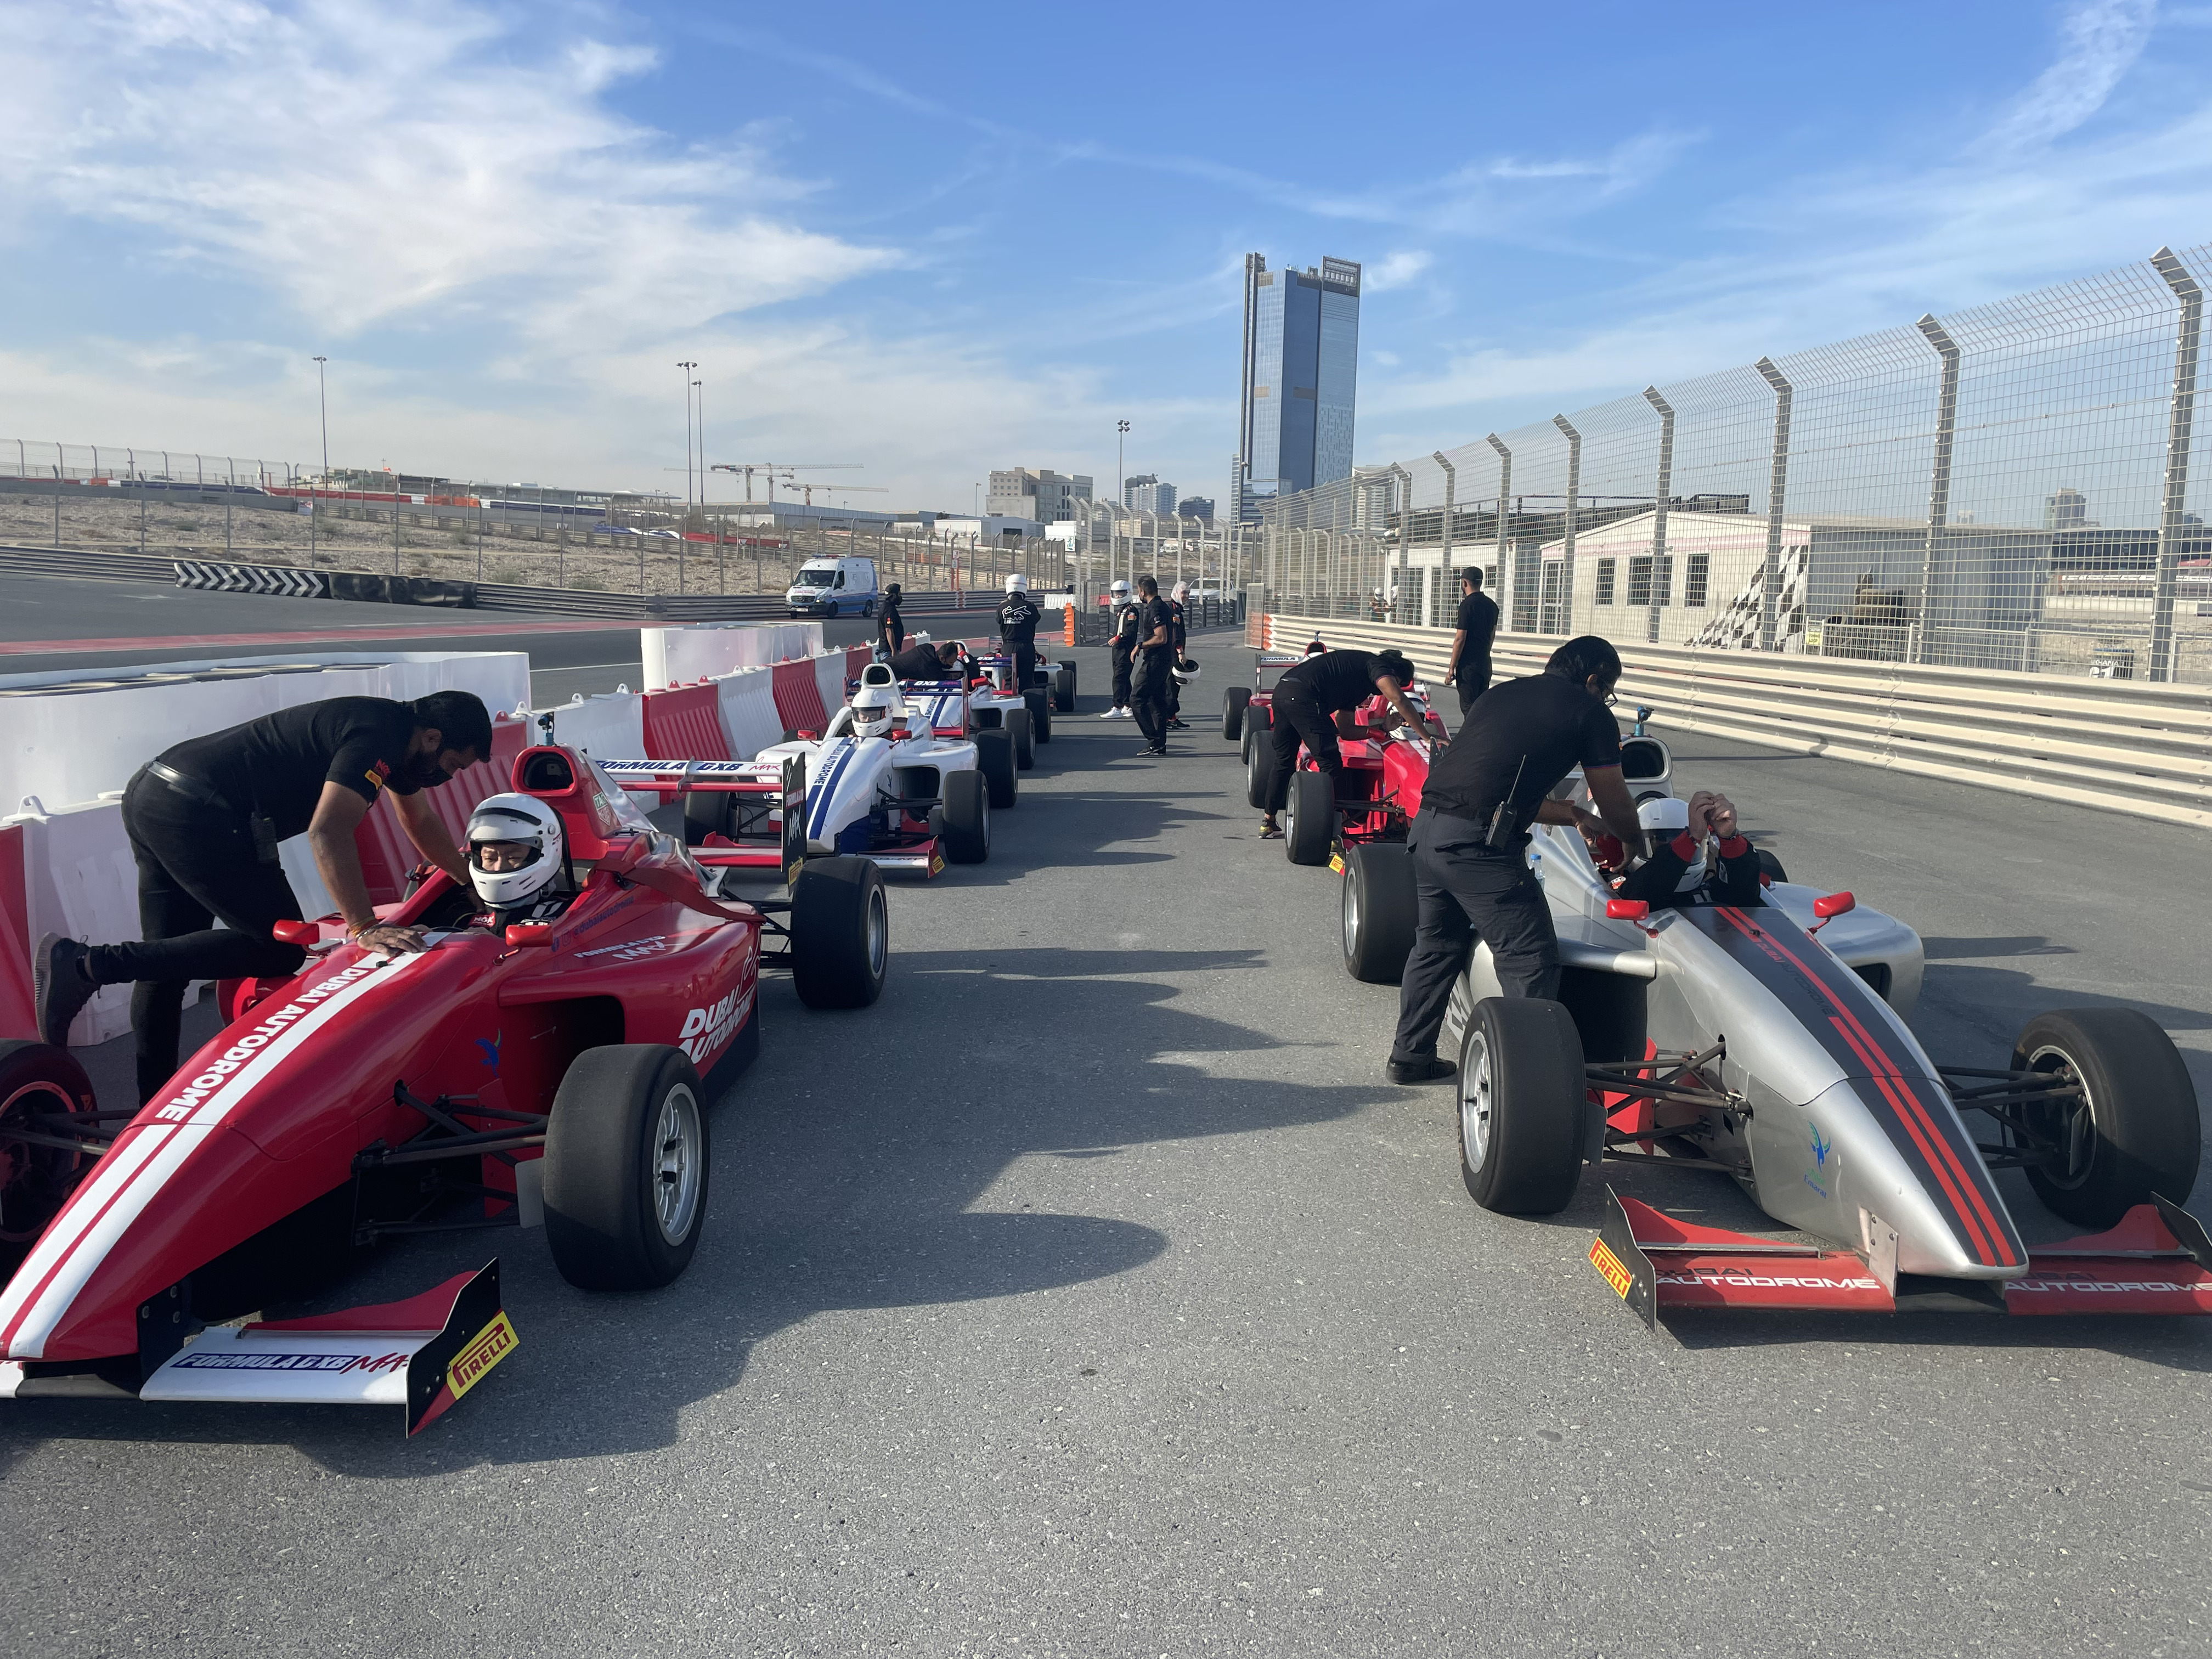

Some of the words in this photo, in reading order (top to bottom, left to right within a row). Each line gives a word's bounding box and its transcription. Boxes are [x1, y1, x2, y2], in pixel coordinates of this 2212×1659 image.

[295, 968, 369, 1003] DUBAI
[679, 984, 740, 1039] DUBAI
[155, 1004, 306, 1121] AUTODROME
[1591, 1241, 1633, 1296] PIRELLI
[1656, 1276, 1881, 1289] AUTODROME
[176, 1355, 302, 1368] FORMULA
[453, 1322, 511, 1388] PIRELLI
